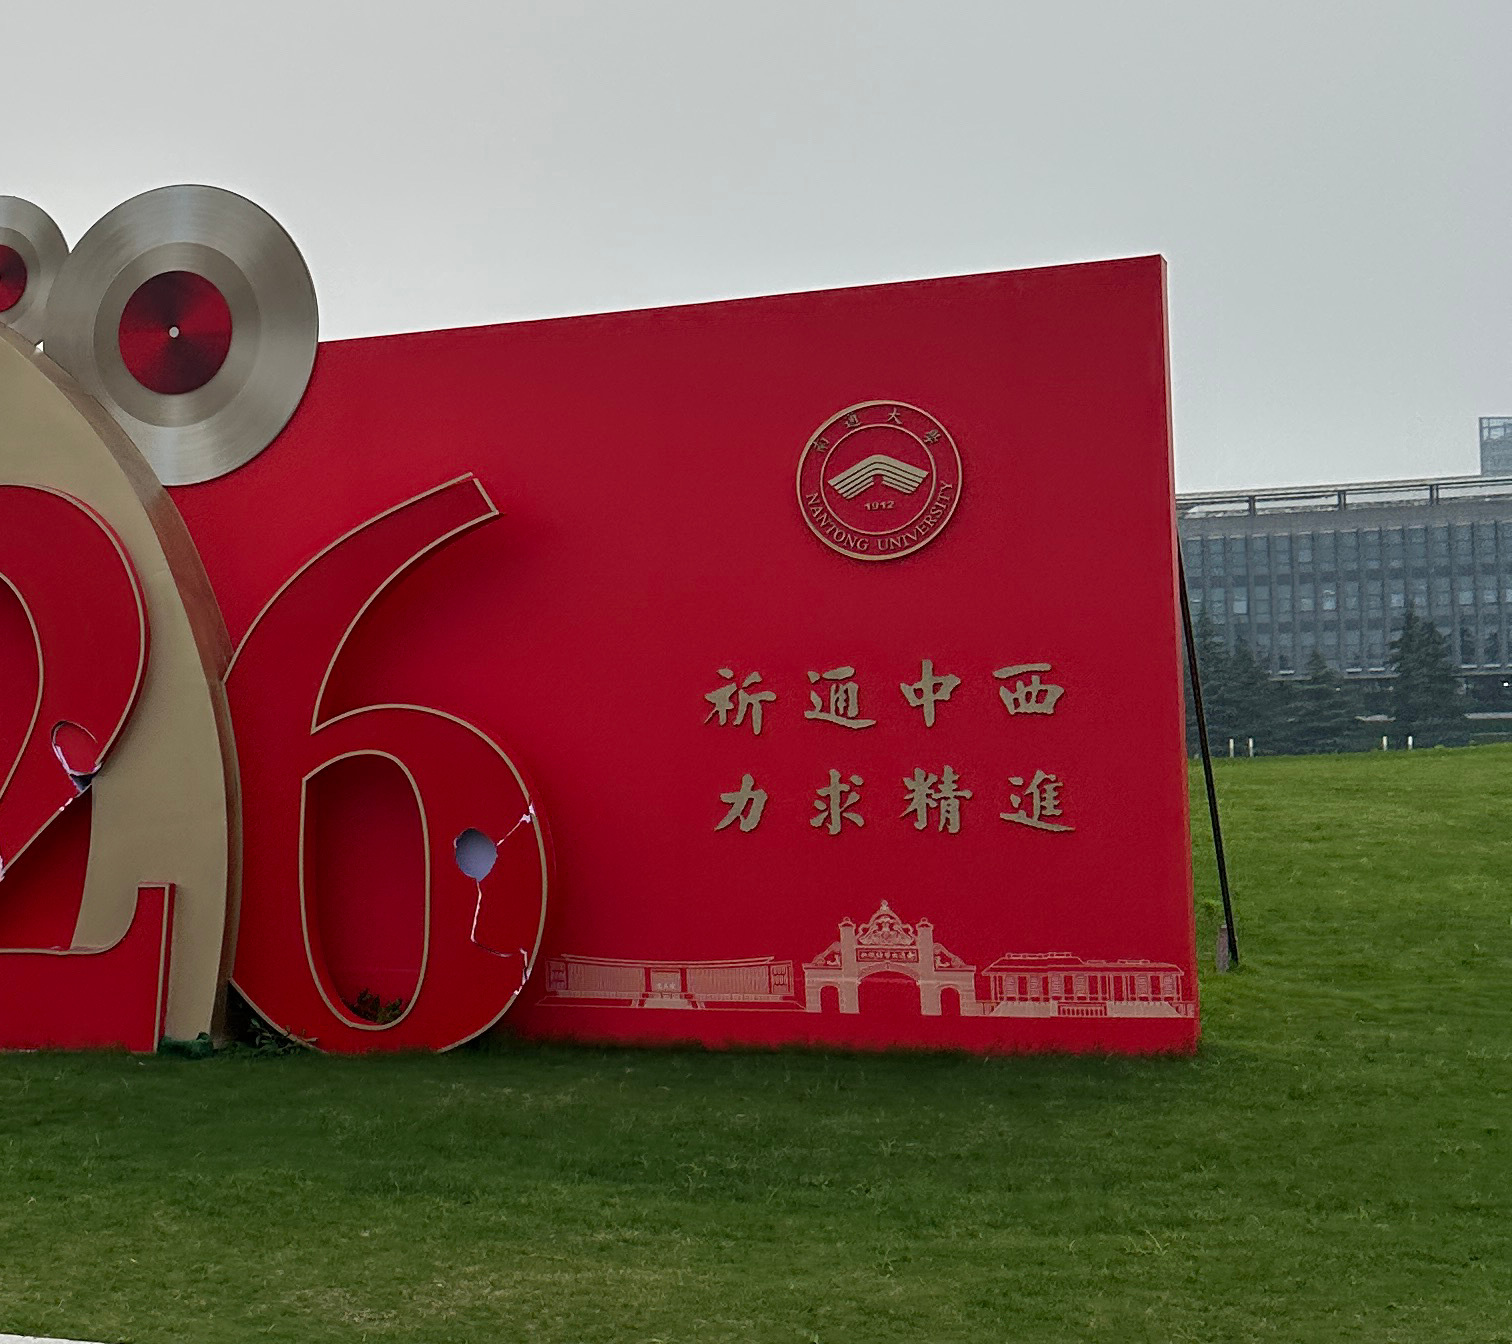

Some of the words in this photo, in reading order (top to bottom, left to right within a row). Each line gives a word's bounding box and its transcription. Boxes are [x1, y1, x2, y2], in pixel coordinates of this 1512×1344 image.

[806, 492, 870, 551] NANTONG
[877, 480, 953, 551] UNIVERSITY
[864, 500, 895, 511] 1912
[703, 659, 1065, 735] 祈通中西
[714, 765, 1076, 836] 力求精進
